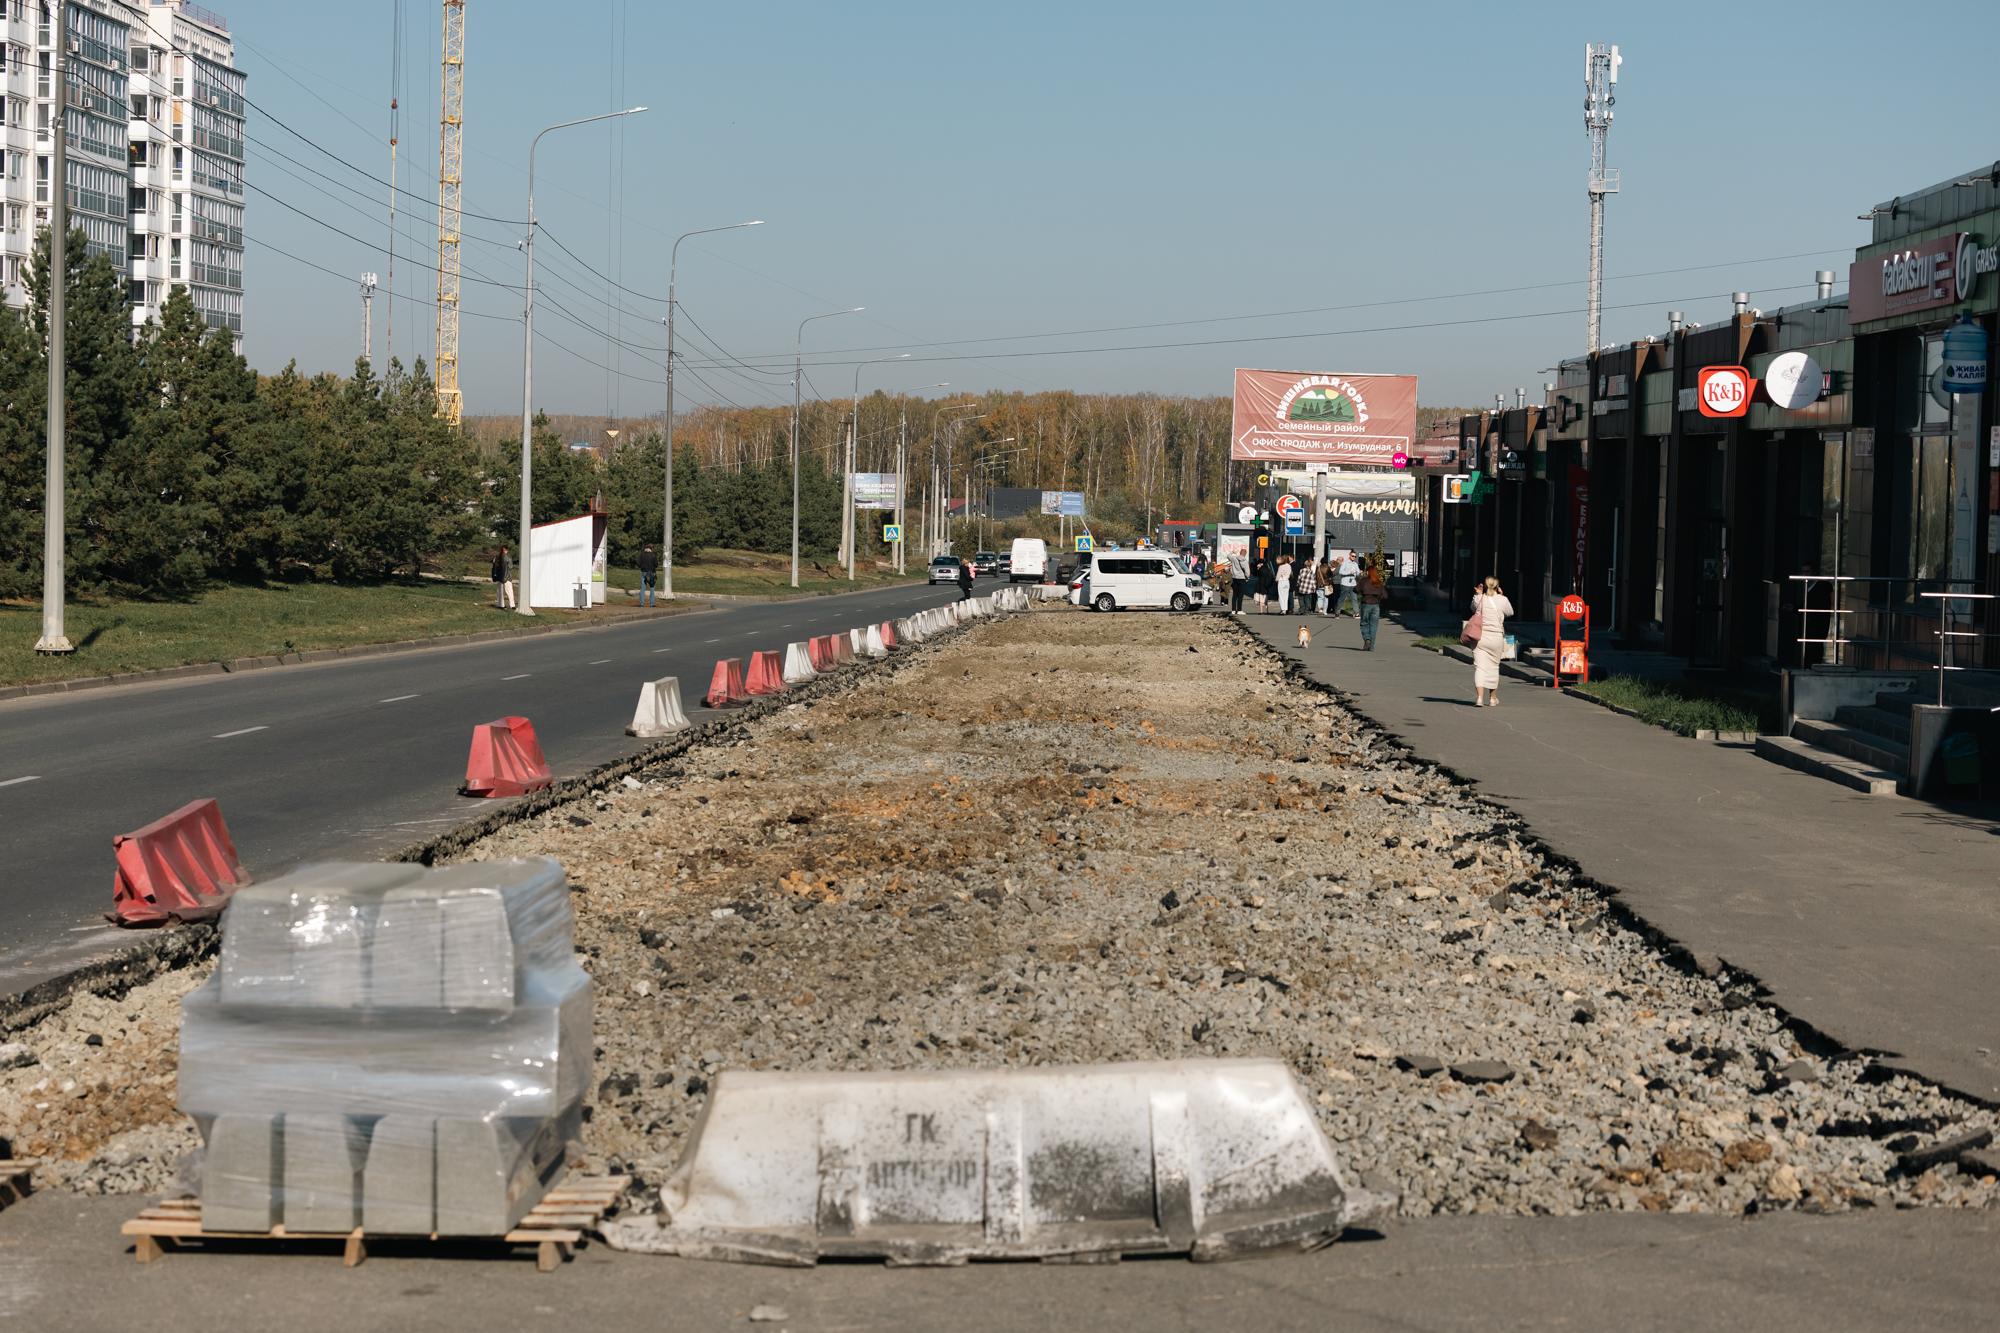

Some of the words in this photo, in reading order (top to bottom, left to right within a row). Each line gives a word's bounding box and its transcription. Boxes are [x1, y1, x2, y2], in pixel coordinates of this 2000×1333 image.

[1975, 246, 1998, 274] GRASS
[1956, 365, 1985, 373] ЖИВАЯ
[1276, 375, 1341, 420] ВИШНЕВАЯ
[1342, 382, 1369, 423] ГОРКА
[1707, 382, 1742, 402] К&Б
[1278, 421, 1332, 432] семейный
[1334, 423, 1366, 433] район
[1252, 438, 1279, 447] ОФИС
[1281, 439, 1320, 449] ПРОДАЖ
[1322, 442, 1334, 451] ул.
[1337, 441, 1394, 452] Изумрудная,
[1563, 601, 1583, 614] К&Б
[905, 1113, 937, 1143] ГК
